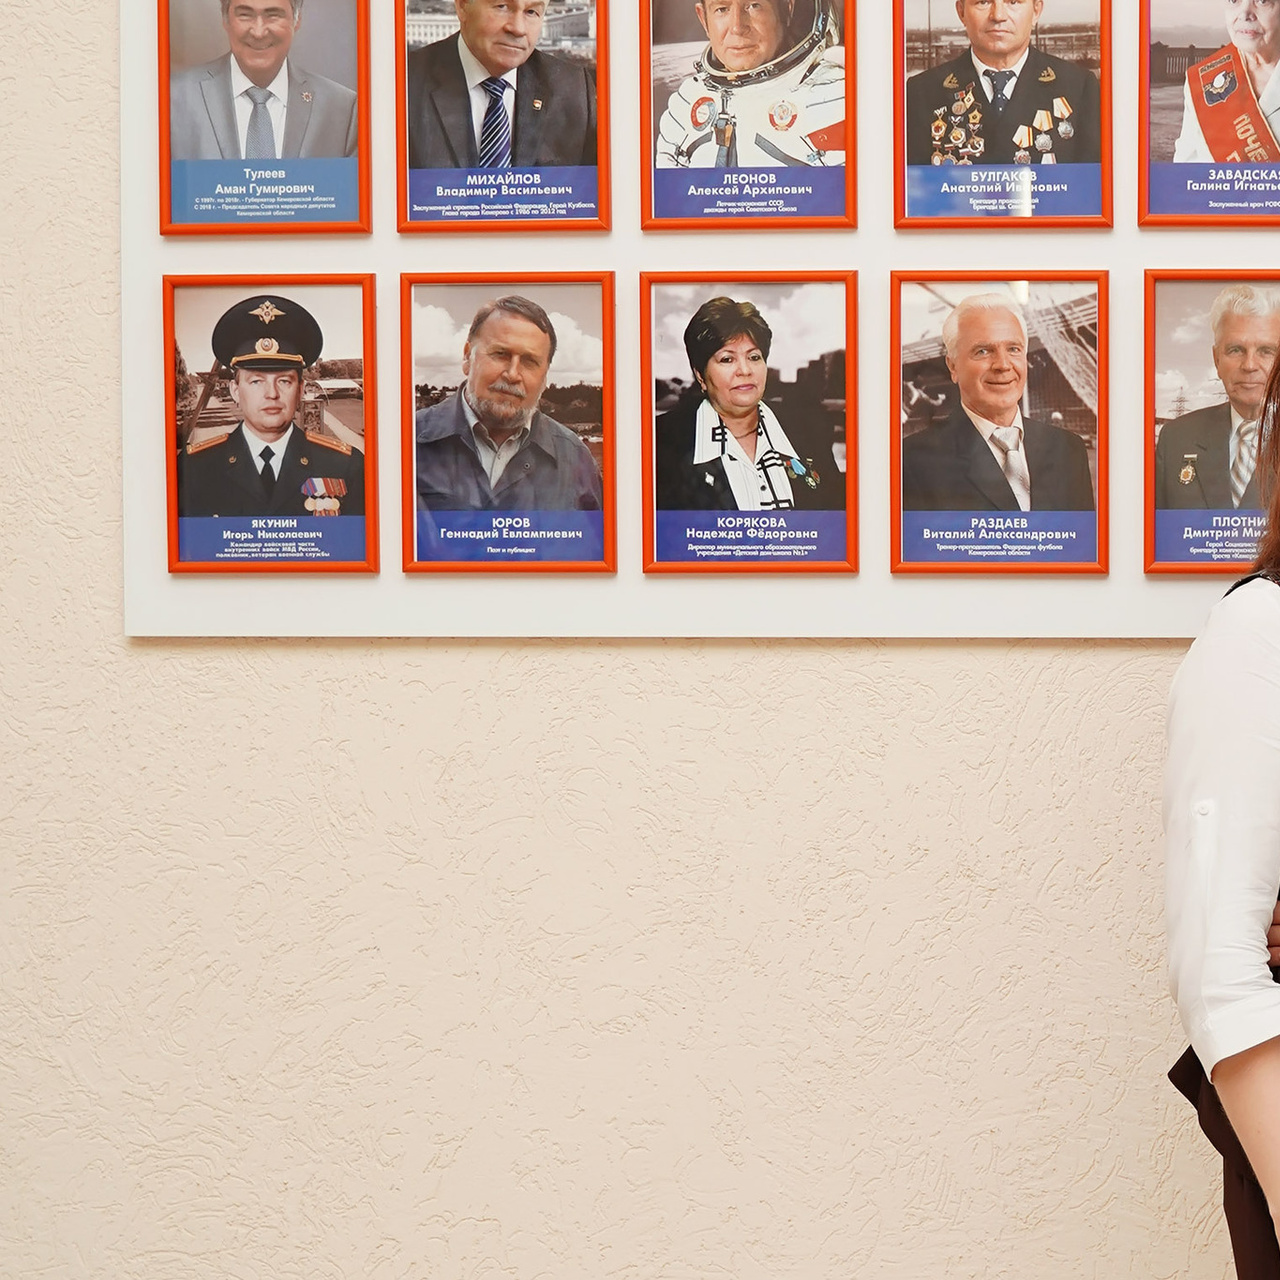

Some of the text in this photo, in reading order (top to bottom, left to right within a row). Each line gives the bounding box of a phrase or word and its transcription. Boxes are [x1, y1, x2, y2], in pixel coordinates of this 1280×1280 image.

[244, 168, 286, 180] Тулеев
[467, 172, 541, 185] МИХАЙЛОВ
[723, 174, 776, 185] ЛЕОНОВ
[215, 184, 315, 195] Аман Гумирович
[688, 184, 812, 198] Алексей Архипович
[941, 182, 1067, 193] Анатолий Ивнович
[1186, 180, 1230, 191] Галина
[436, 185, 572, 198] Владимир Васильевич
[251, 519, 297, 528] ЯКУНИН
[492, 518, 531, 528] ЮРОВ
[717, 517, 787, 528] КОРЯКОВА
[971, 518, 1028, 530] РАЗДАЕВ
[1213, 517, 1269, 527] ПЛОТНИ
[223, 530, 322, 541] Игорь Николаевич
[440, 528, 582, 539] Геннадий Евлампиевич
[686, 528, 818, 540] Надежда Фёдоровна
[923, 528, 1076, 541] Виталий Александрович
[1183, 527, 1239, 540] Дмитрий
